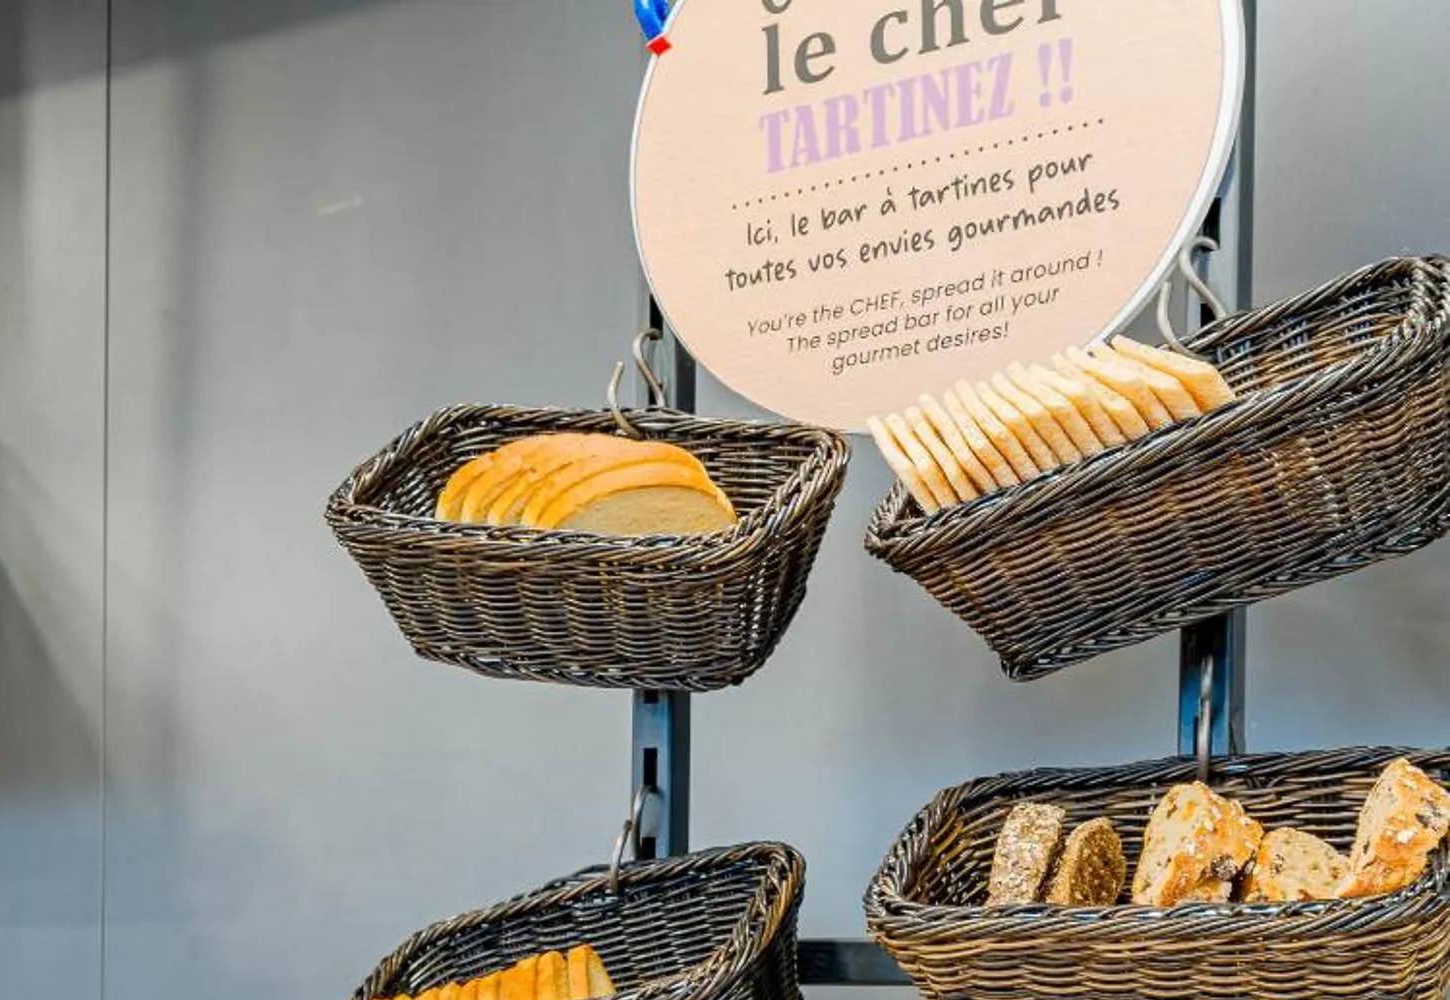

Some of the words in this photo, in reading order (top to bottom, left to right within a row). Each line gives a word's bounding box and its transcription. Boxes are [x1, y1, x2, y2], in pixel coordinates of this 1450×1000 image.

[761, 23, 837, 96] le
[758, 52, 1017, 174] TARTINEZ
[1037, 37, 1075, 108] !!
[724, 258, 798, 292] toutes
[807, 246, 848, 273] vos
[859, 228, 936, 264] envies
[947, 186, 1122, 252] gourmandes
[747, 220, 778, 247] Ici,
[791, 213, 809, 238] le
[821, 204, 867, 230] bar
[880, 186, 897, 216] à
[907, 167, 1015, 211] tartines
[1027, 152, 1094, 194] pour
[747, 309, 808, 338] You're
[813, 302, 845, 322] the
[849, 290, 904, 317] CHEF,
[910, 275, 986, 306] spread
[990, 268, 1004, 287] it
[1009, 249, 1092, 284] around
[786, 334, 821, 354] The
[826, 317, 900, 348] spread
[904, 311, 939, 331] bar
[944, 302, 973, 323] for
[979, 293, 1006, 317] all
[1010, 286, 1061, 316] your
[831, 340, 921, 376] gourmet
[926, 321, 1011, 353] desires!
